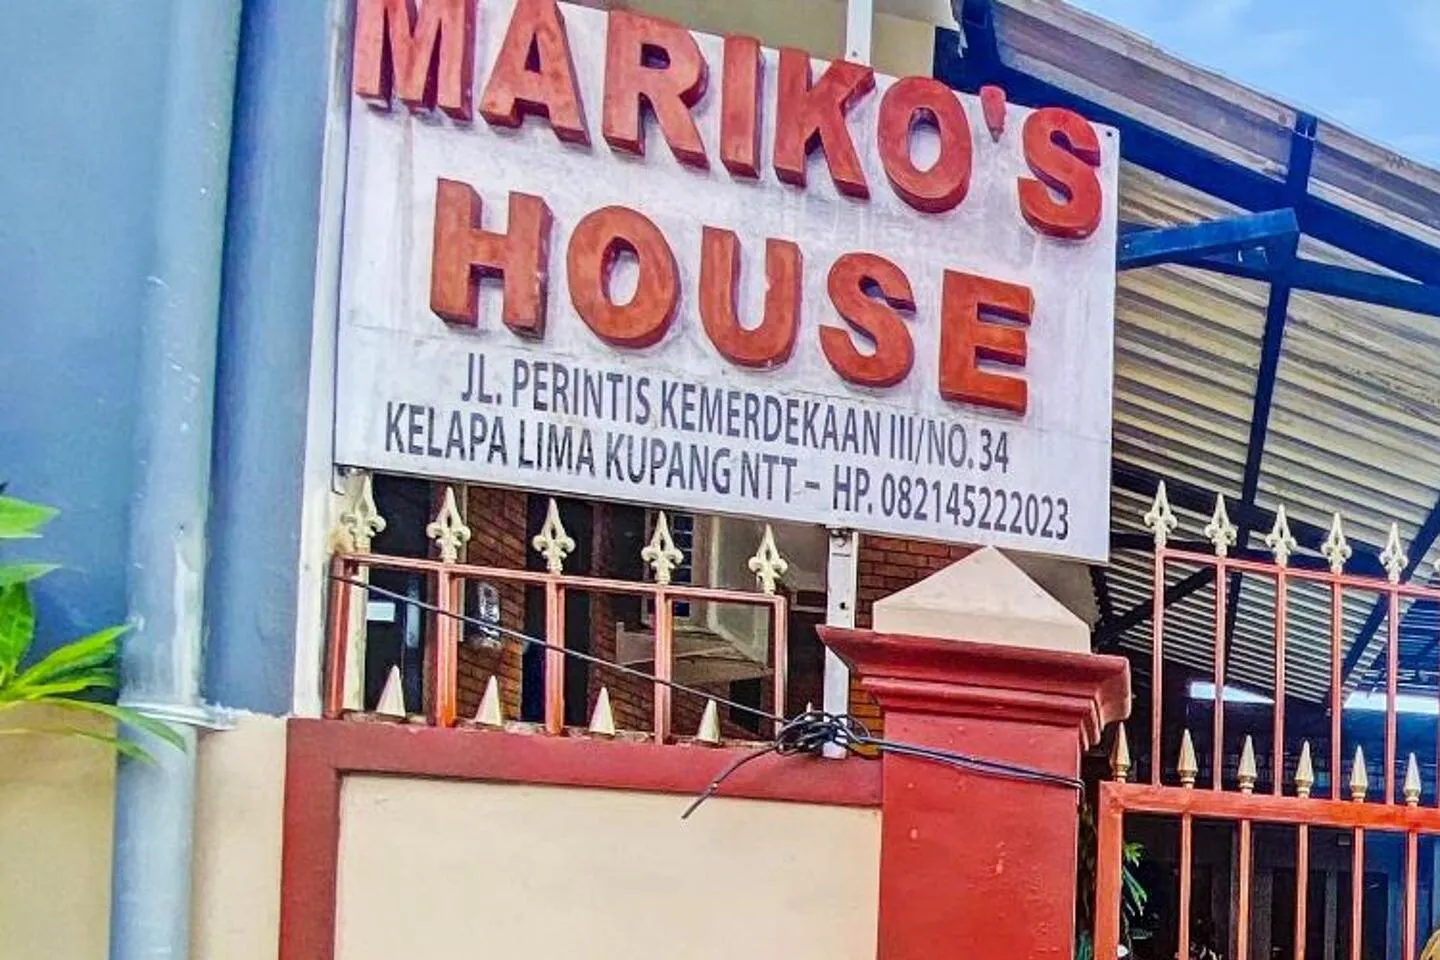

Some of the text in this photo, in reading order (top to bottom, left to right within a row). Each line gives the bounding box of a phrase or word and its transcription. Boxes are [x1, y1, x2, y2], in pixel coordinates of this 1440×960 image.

[353, 0, 1103, 239] MARIKO'S
[429, 177, 1034, 415] HOUSE
[385, 401, 508, 466] KELAPA
[518, 419, 596, 477] LIMA
[605, 431, 731, 495] KUPANG
[740, 450, 798, 504] NTT
[832, 464, 873, 515] HP.
[880, 472, 1069, 541] 082145222023
[461, 352, 502, 405] JL.
[512, 358, 650, 426] PERINTIS
[660, 379, 881, 457] KEMERDEKAAN
